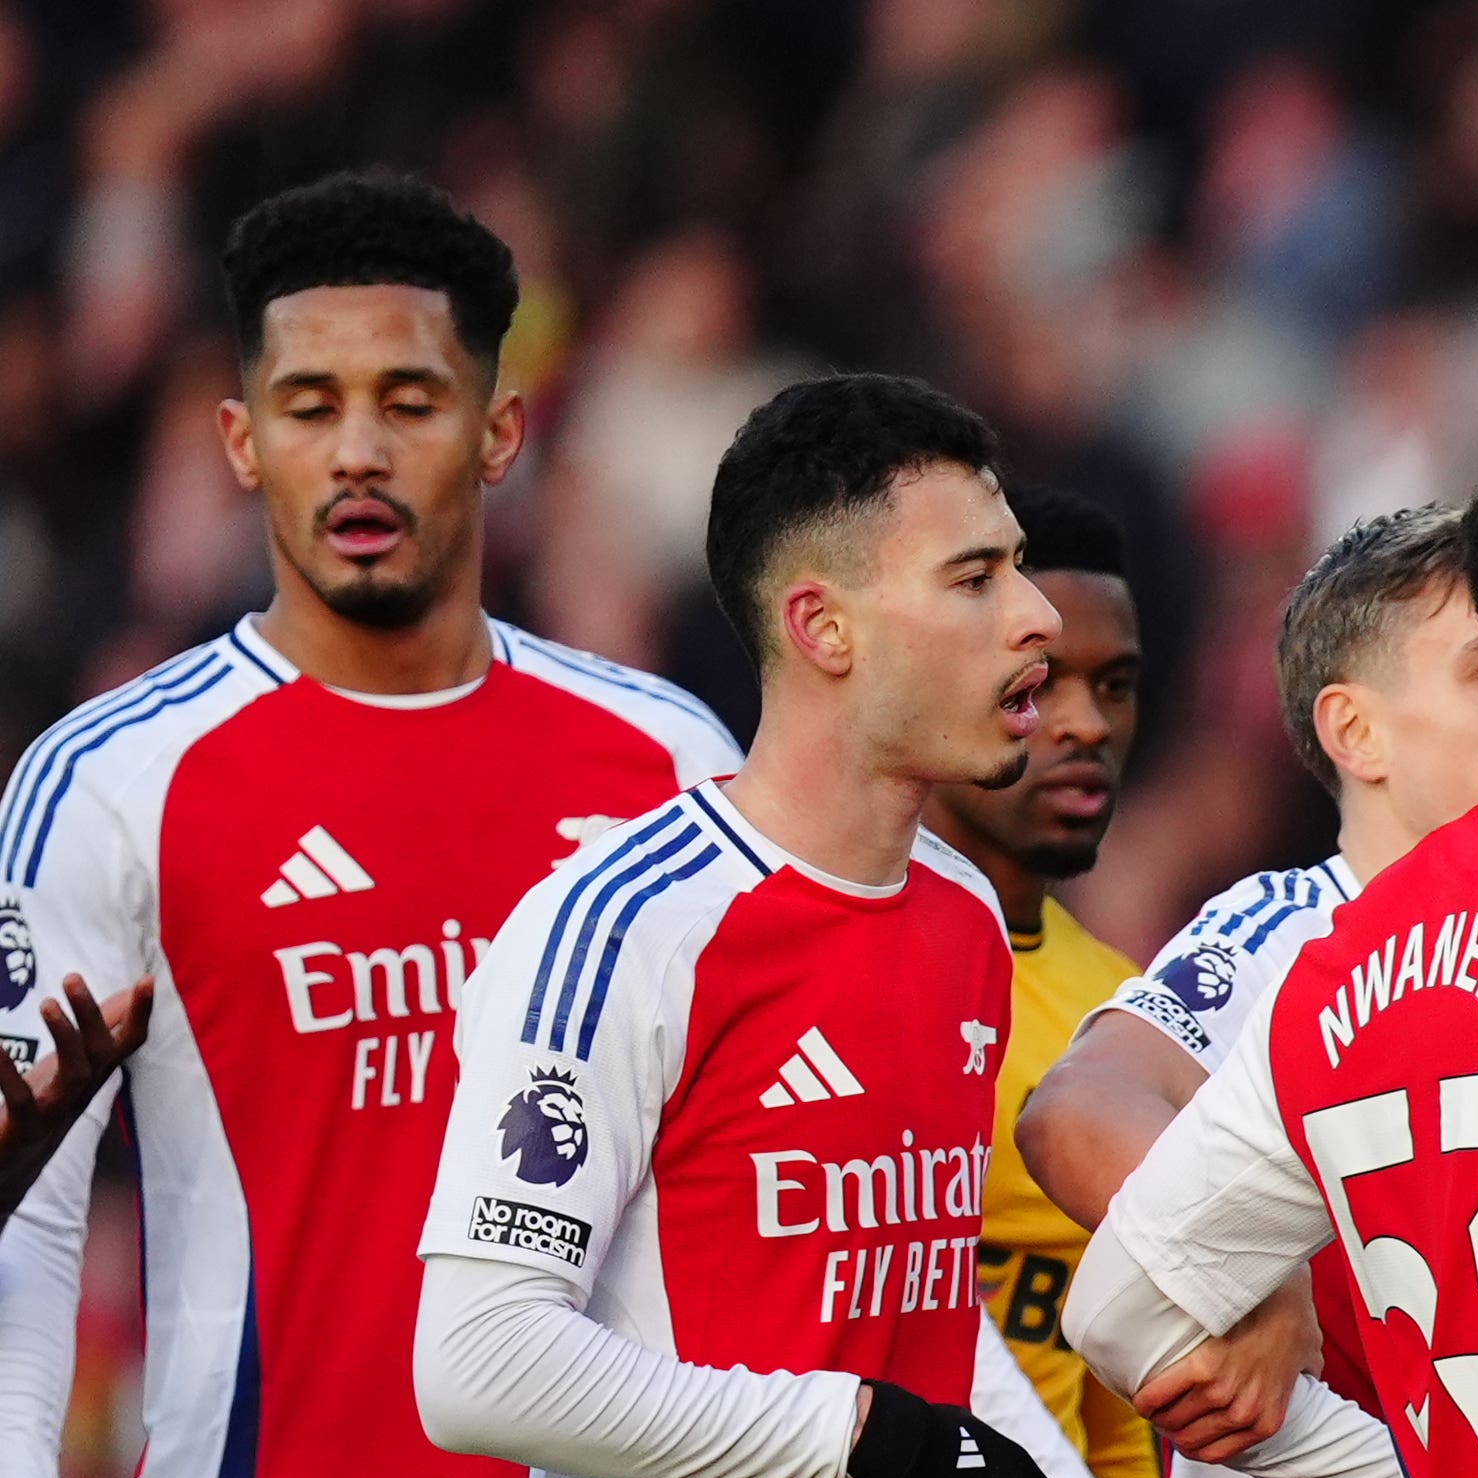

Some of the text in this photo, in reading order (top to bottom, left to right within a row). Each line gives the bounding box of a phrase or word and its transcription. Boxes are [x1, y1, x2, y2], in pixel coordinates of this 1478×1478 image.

[351, 1030, 435, 1110] FLY
[469, 1218, 585, 1268] for racism
[472, 1197, 581, 1244] No room
[820, 1236, 981, 1323] FLY BETT
